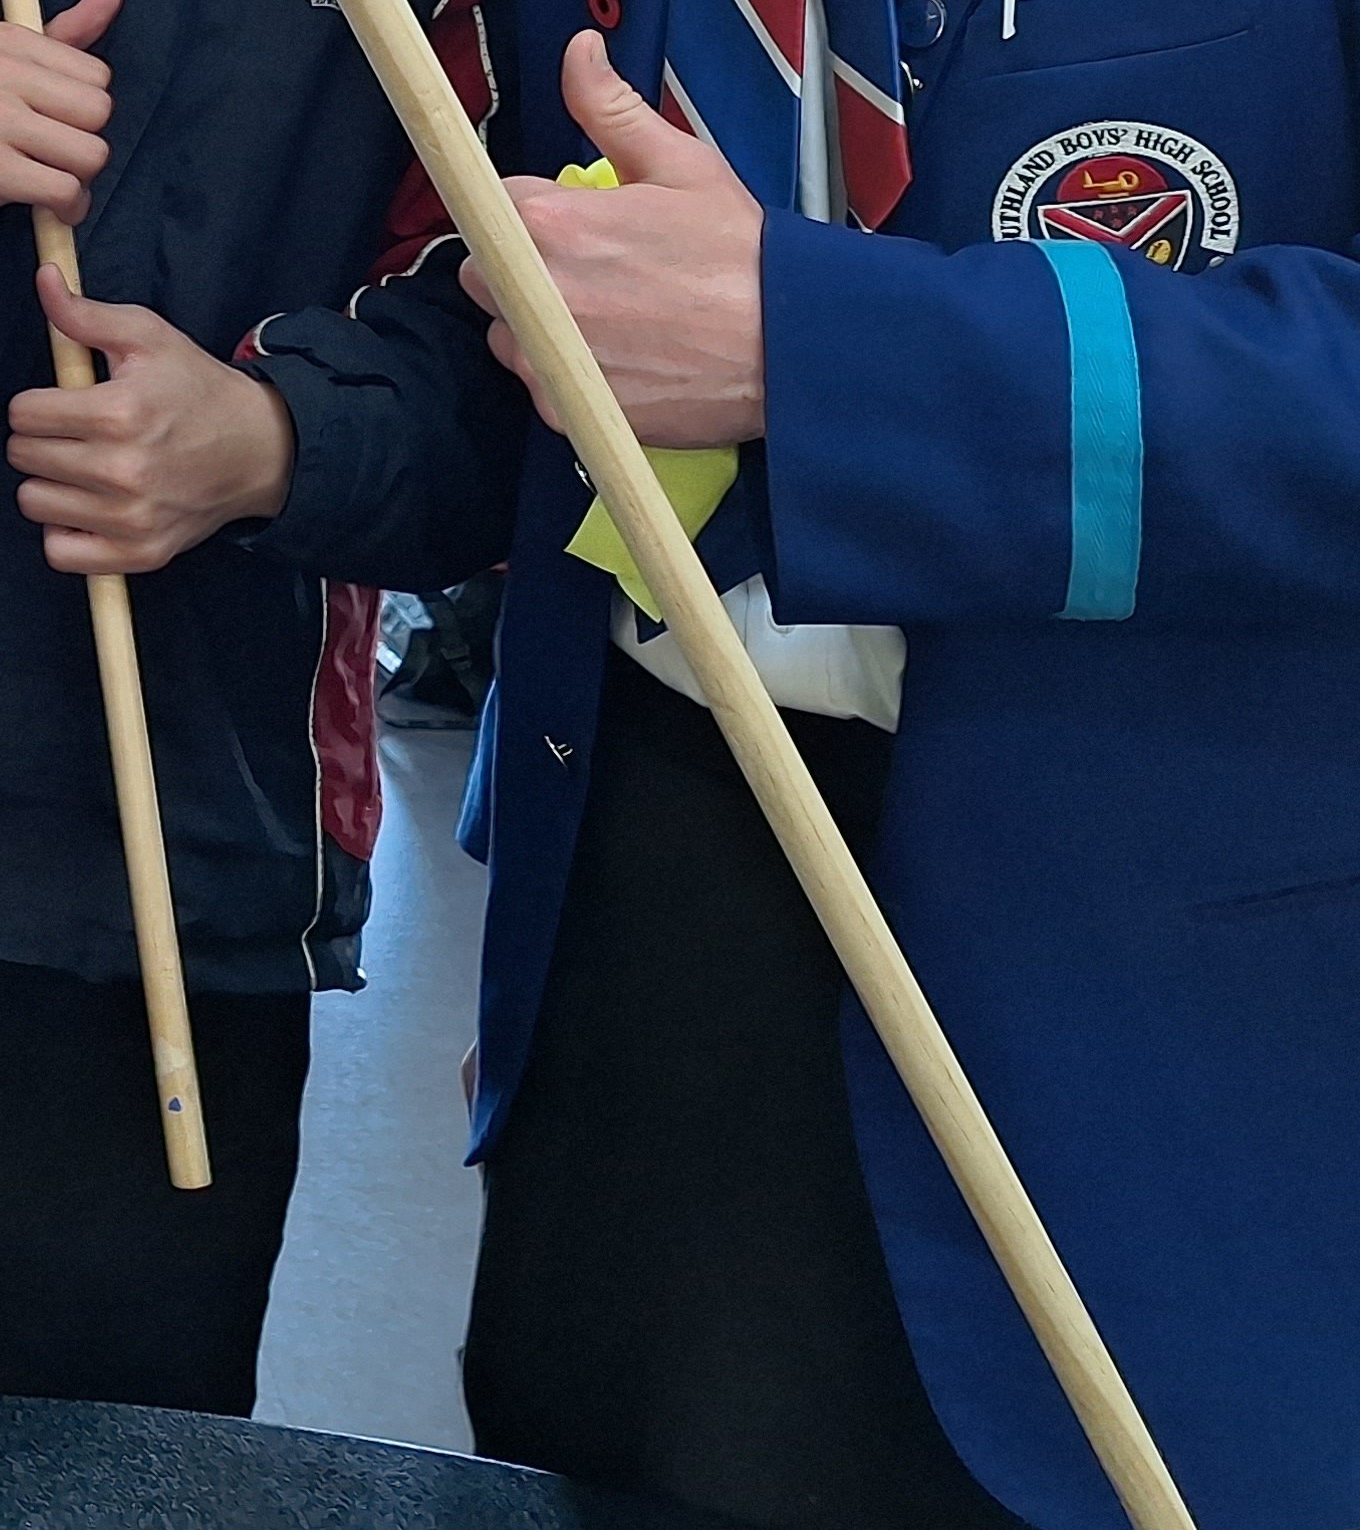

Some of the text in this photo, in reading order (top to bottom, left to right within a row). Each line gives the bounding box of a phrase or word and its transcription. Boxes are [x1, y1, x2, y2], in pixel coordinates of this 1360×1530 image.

[999, 128, 1233, 242] UTHLAND BOYS' HIGH SCHOOL
